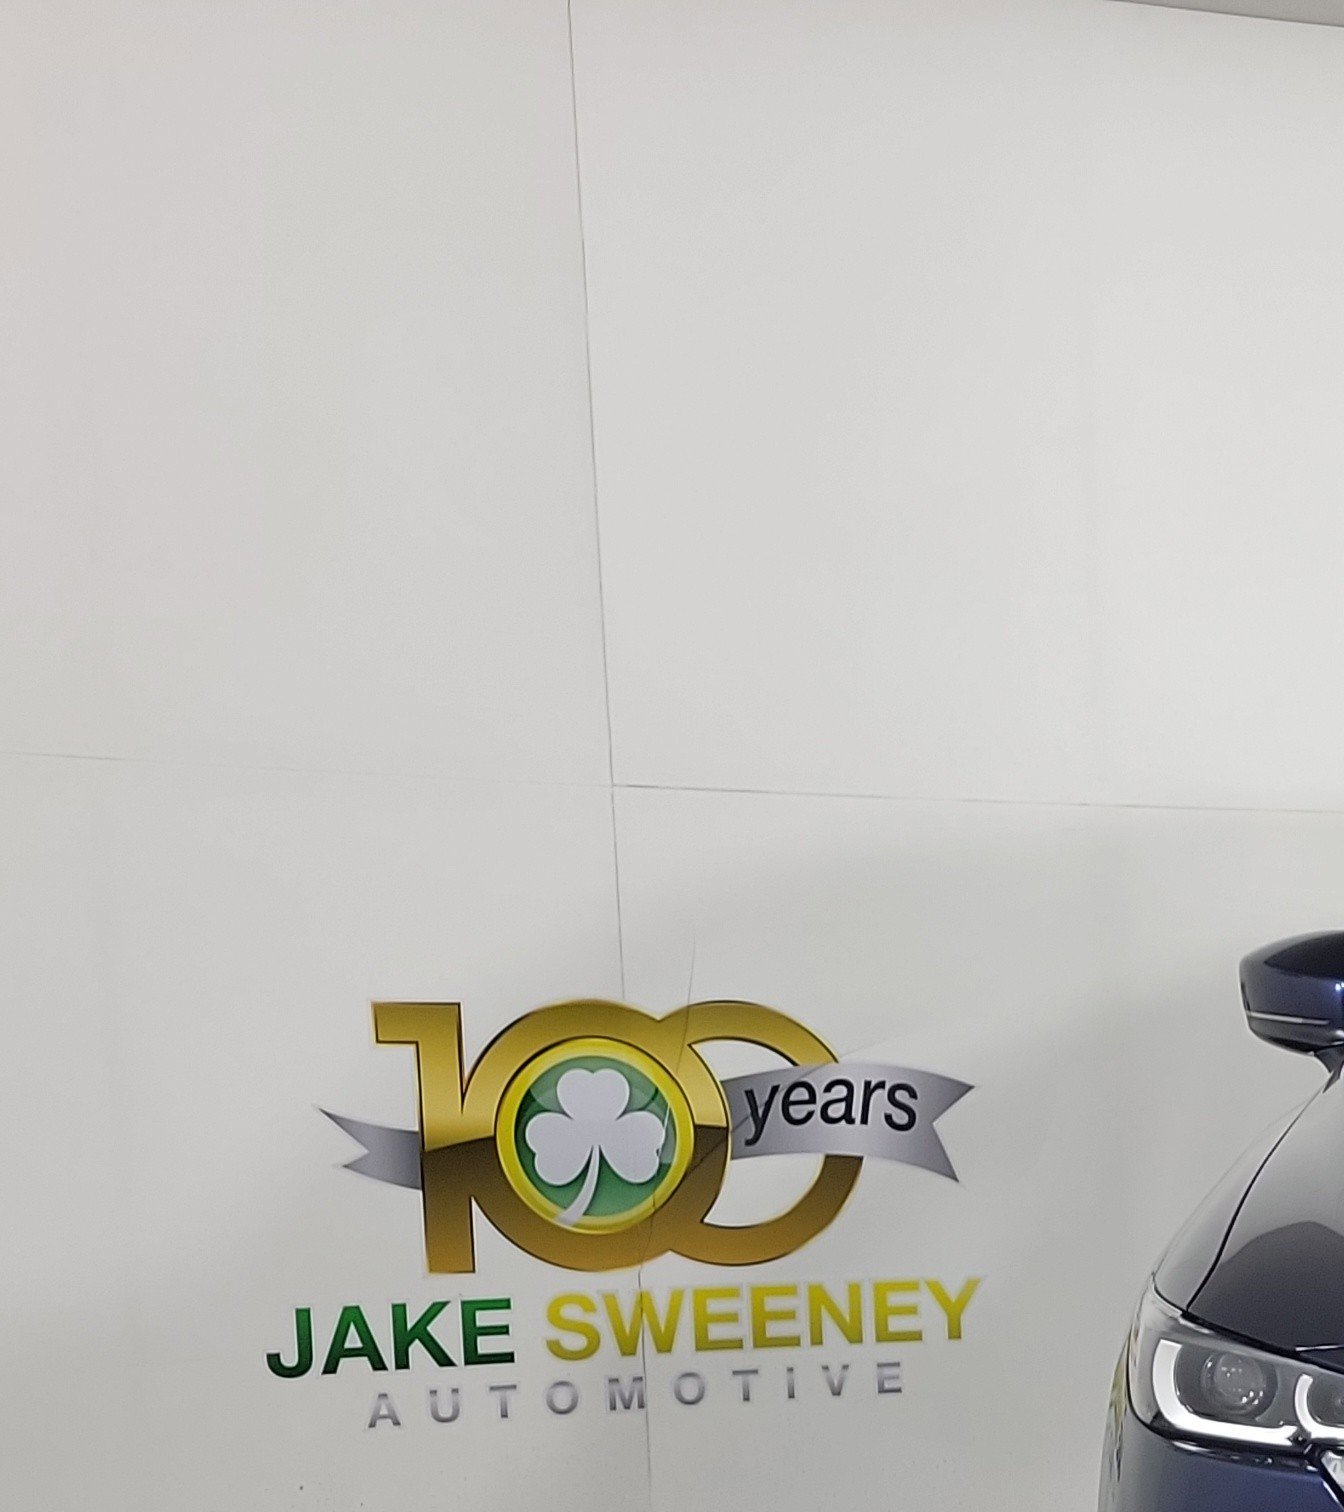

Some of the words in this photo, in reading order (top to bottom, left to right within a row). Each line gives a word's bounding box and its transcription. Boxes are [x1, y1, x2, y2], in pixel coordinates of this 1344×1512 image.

[744, 1078, 918, 1146] years
[266, 1297, 515, 1379] JAKE
[545, 1277, 982, 1361] SWEENEY
[367, 1362, 903, 1429] AUTOMOTIVE
